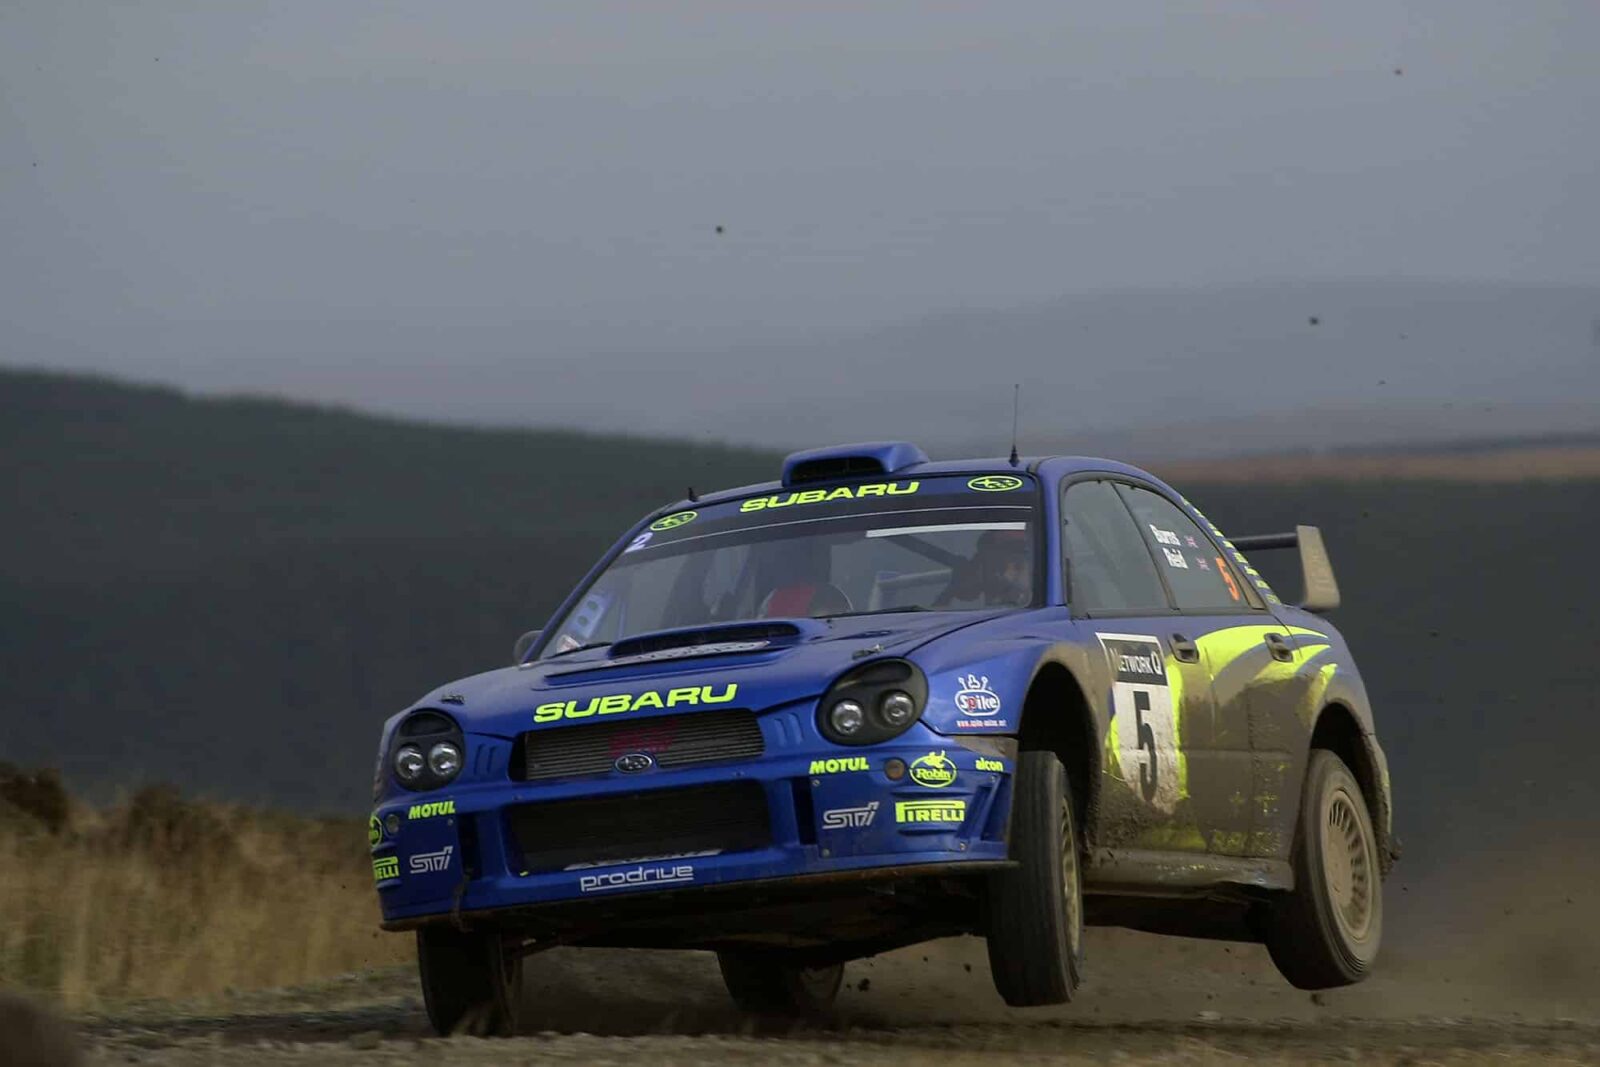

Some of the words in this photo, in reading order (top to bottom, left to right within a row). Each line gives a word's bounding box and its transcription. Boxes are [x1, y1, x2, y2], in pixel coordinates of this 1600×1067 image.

[739, 481, 920, 513] SUBARU
[1215, 556, 1240, 601] 5
[533, 683, 738, 723] SUBARU
[959, 694, 999, 713] Spike
[1132, 690, 1159, 803] 5
[808, 757, 870, 775] MOTUL
[916, 768, 952, 782] Robin
[975, 757, 1004, 772] alcon
[408, 801, 456, 820] MOTUL
[895, 800, 966, 823] PIRELLI
[373, 856, 400, 880] ELLI
[580, 865, 694, 892] prodrive
